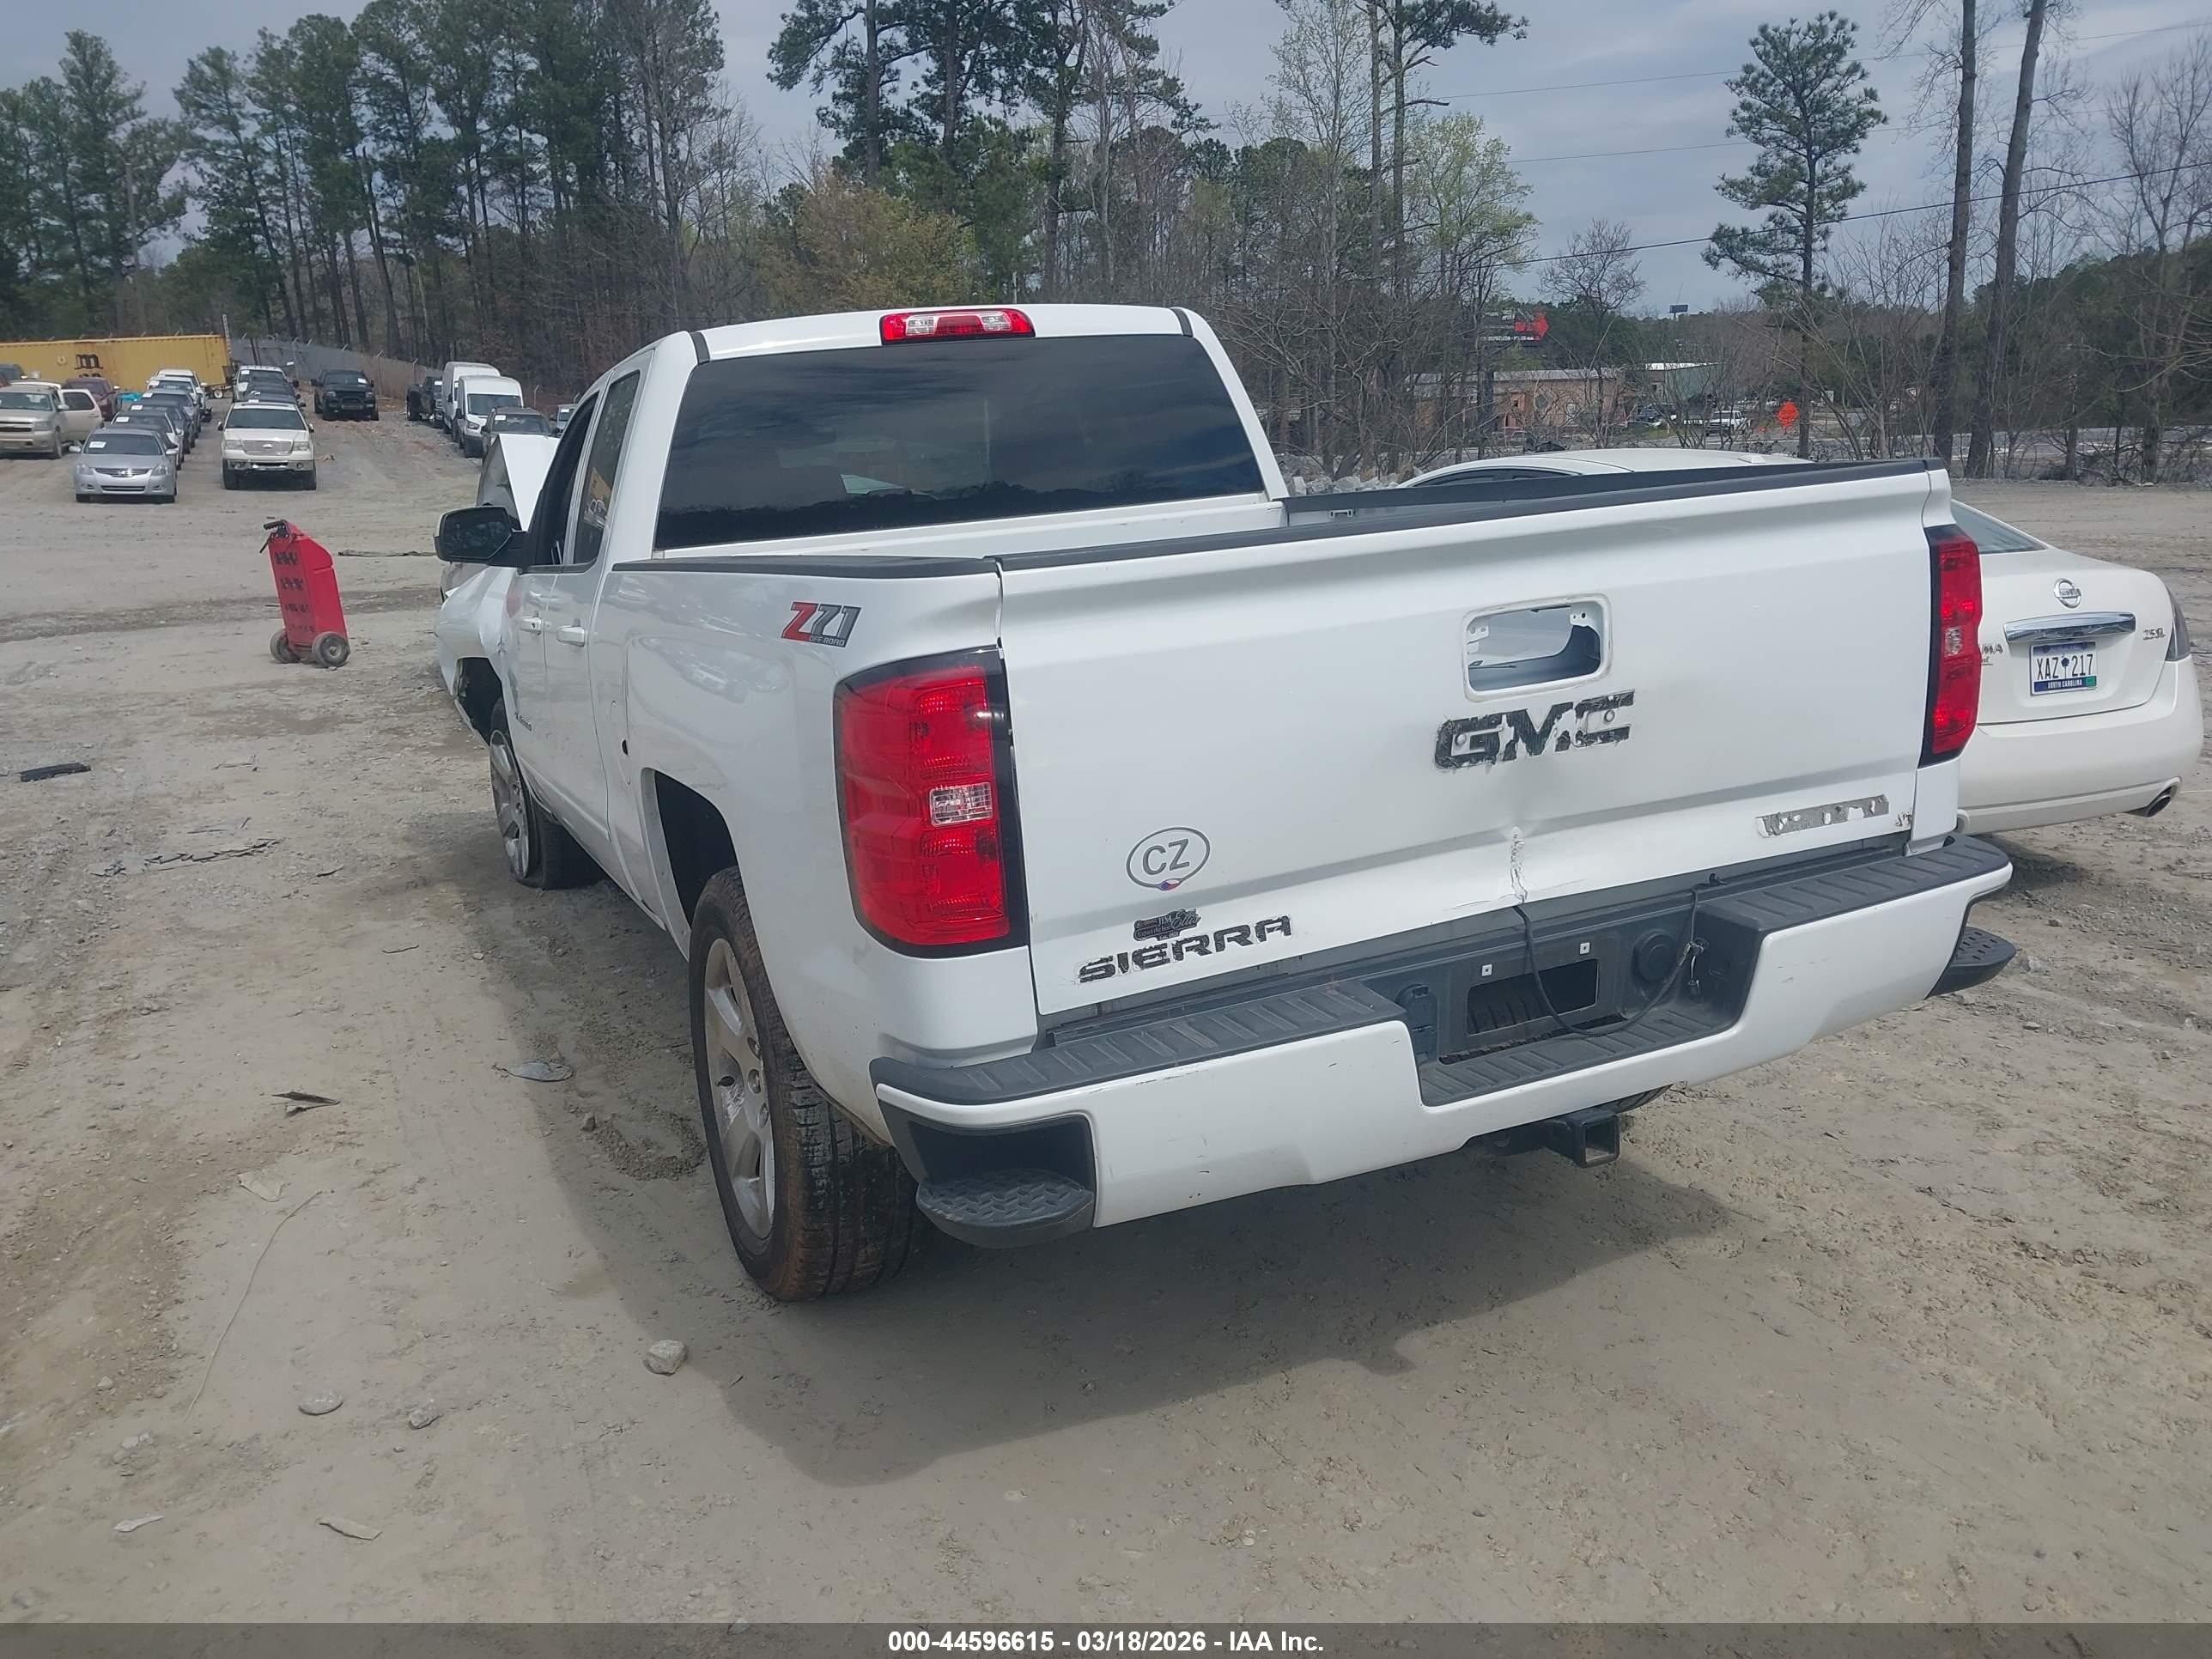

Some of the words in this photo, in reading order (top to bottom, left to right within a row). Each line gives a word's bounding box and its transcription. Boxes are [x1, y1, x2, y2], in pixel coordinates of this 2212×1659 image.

[781, 601, 861, 642] Z71
[2037, 657, 2059, 680] XAZ
[2071, 654, 2094, 677] 217
[2048, 681, 2062, 690] SOUTH
[2062, 679, 2083, 688] CAROLINA
[1435, 690, 1635, 770] GMC
[1142, 838, 1190, 876] CZ
[1077, 915, 1292, 985] SIERRA
